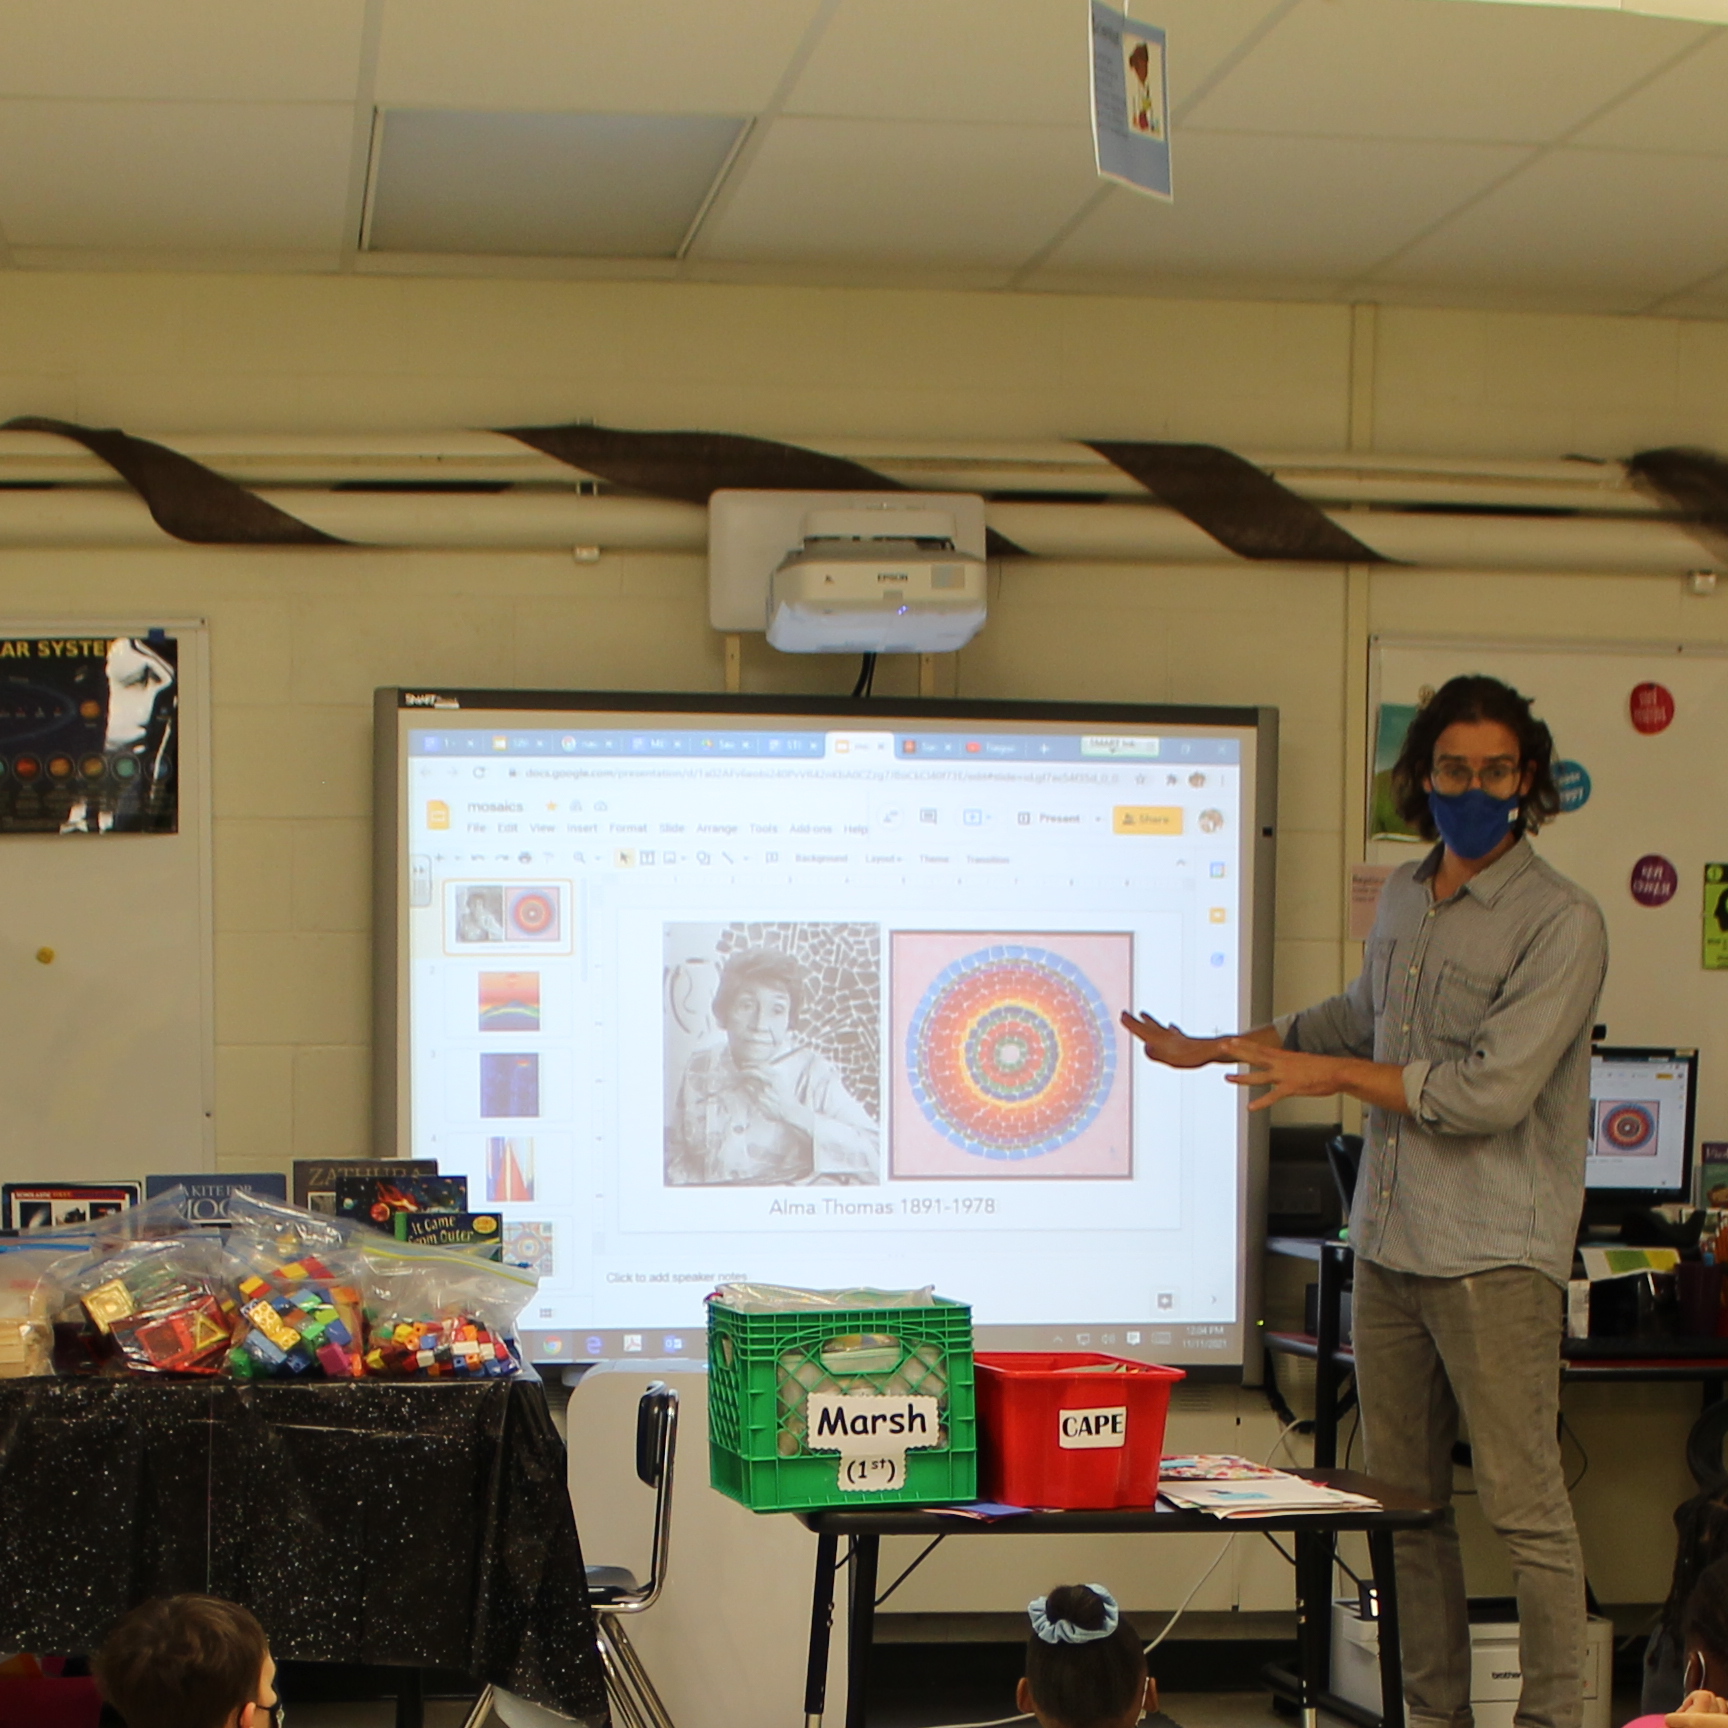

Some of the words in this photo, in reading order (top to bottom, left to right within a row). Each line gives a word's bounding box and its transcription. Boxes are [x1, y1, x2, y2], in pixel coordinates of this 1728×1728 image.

[37, 639, 115, 658] SYSTE
[467, 799, 524, 814] mosaics
[1038, 812, 1081, 826] Present
[1138, 813, 1170, 826] Share
[467, 822, 486, 835] File
[497, 822, 519, 835] Edit
[529, 822, 556, 835] View
[567, 822, 598, 835] Insert
[609, 822, 648, 835] Format
[659, 822, 685, 835] Slide
[697, 822, 739, 838] Arrange
[749, 822, 778, 835] Tools
[789, 823, 833, 836] Add-ons
[843, 823, 869, 838] Help
[795, 852, 849, 866] Background
[918, 853, 950, 865] Theme
[965, 854, 1010, 866] Transition
[190, 1184, 224, 1198] KITE
[769, 1198, 817, 1217] Alma
[820, 1198, 894, 1217] Thomas
[899, 1197, 997, 1217] 1891-1978
[424, 1216, 456, 1232] Came
[439, 1230, 474, 1244] Outer
[606, 1271, 631, 1285] Click
[633, 1271, 643, 1284] to
[645, 1271, 666, 1284] add
[671, 1271, 717, 1287] speaker
[719, 1272, 748, 1285] notes
[815, 1403, 928, 1440] Marsh
[1061, 1412, 1124, 1439] CAPE
[846, 1455, 897, 1484] (1st)
